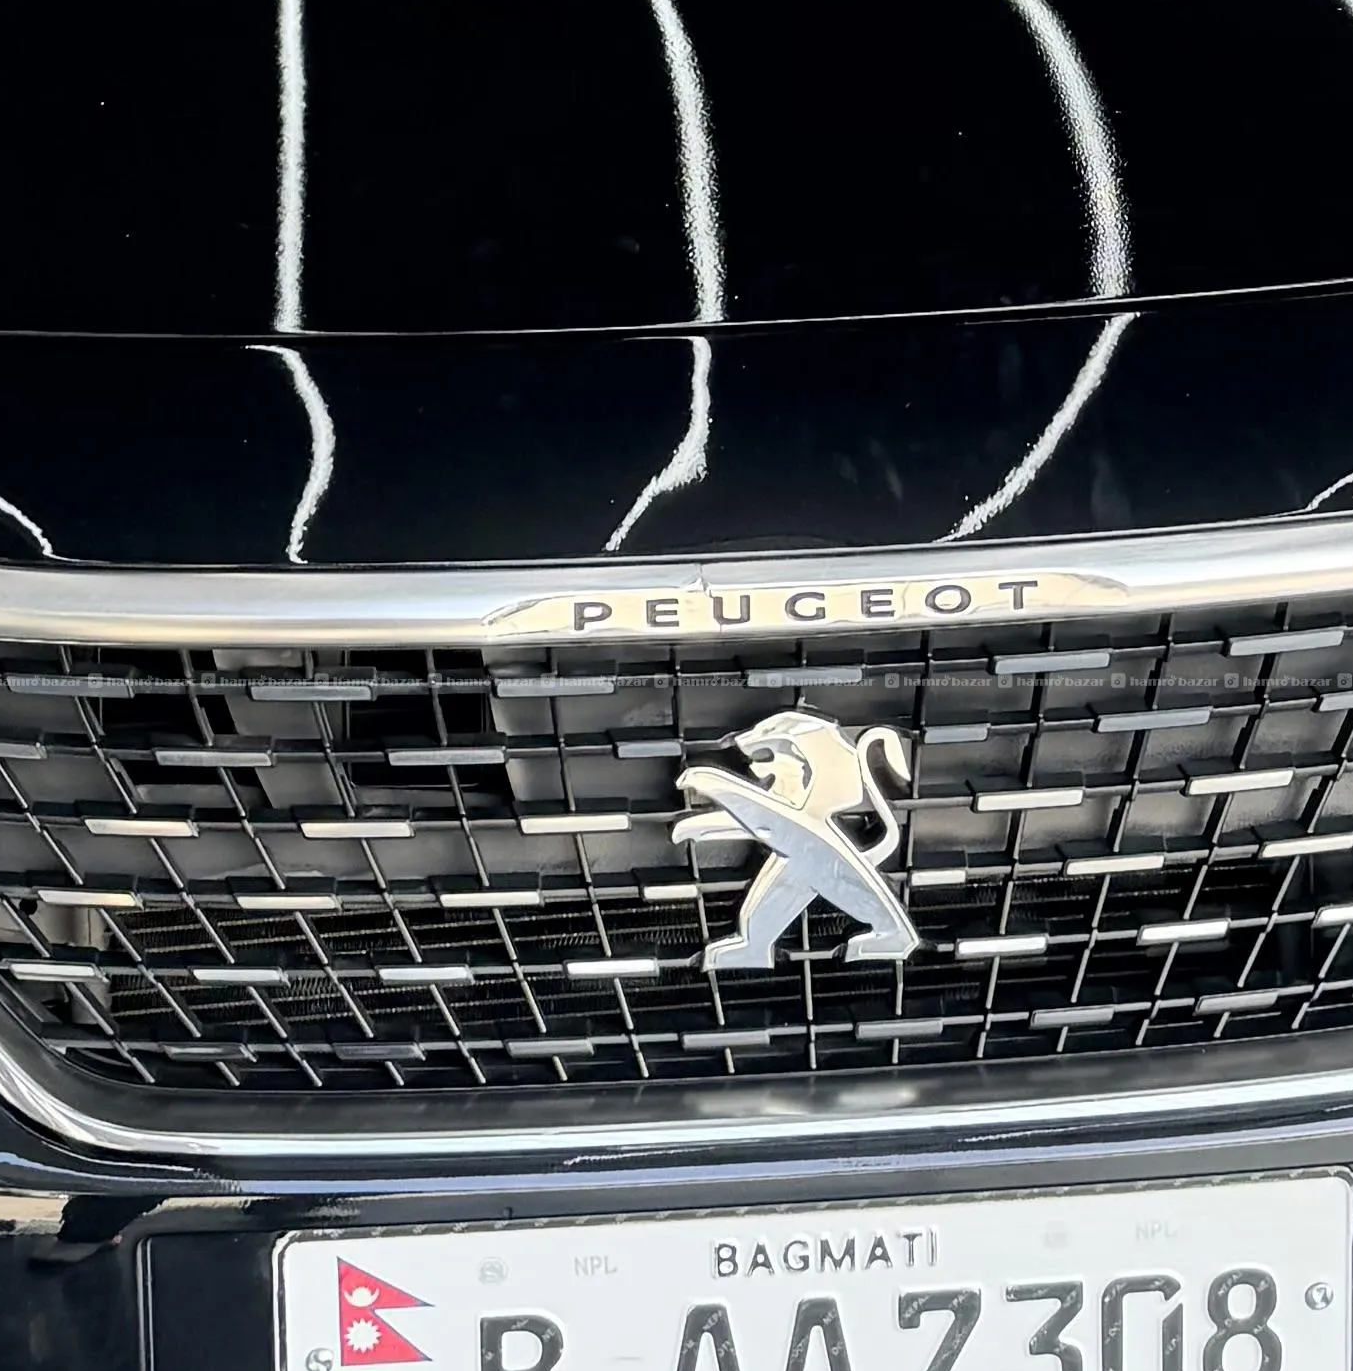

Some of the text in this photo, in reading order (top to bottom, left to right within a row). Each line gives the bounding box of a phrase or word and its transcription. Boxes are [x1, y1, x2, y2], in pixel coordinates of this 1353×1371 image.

[572, 580, 1039, 632] PEUGEOT
[574, 1254, 618, 1277] NPL
[712, 1227, 939, 1278] BAGMATI
